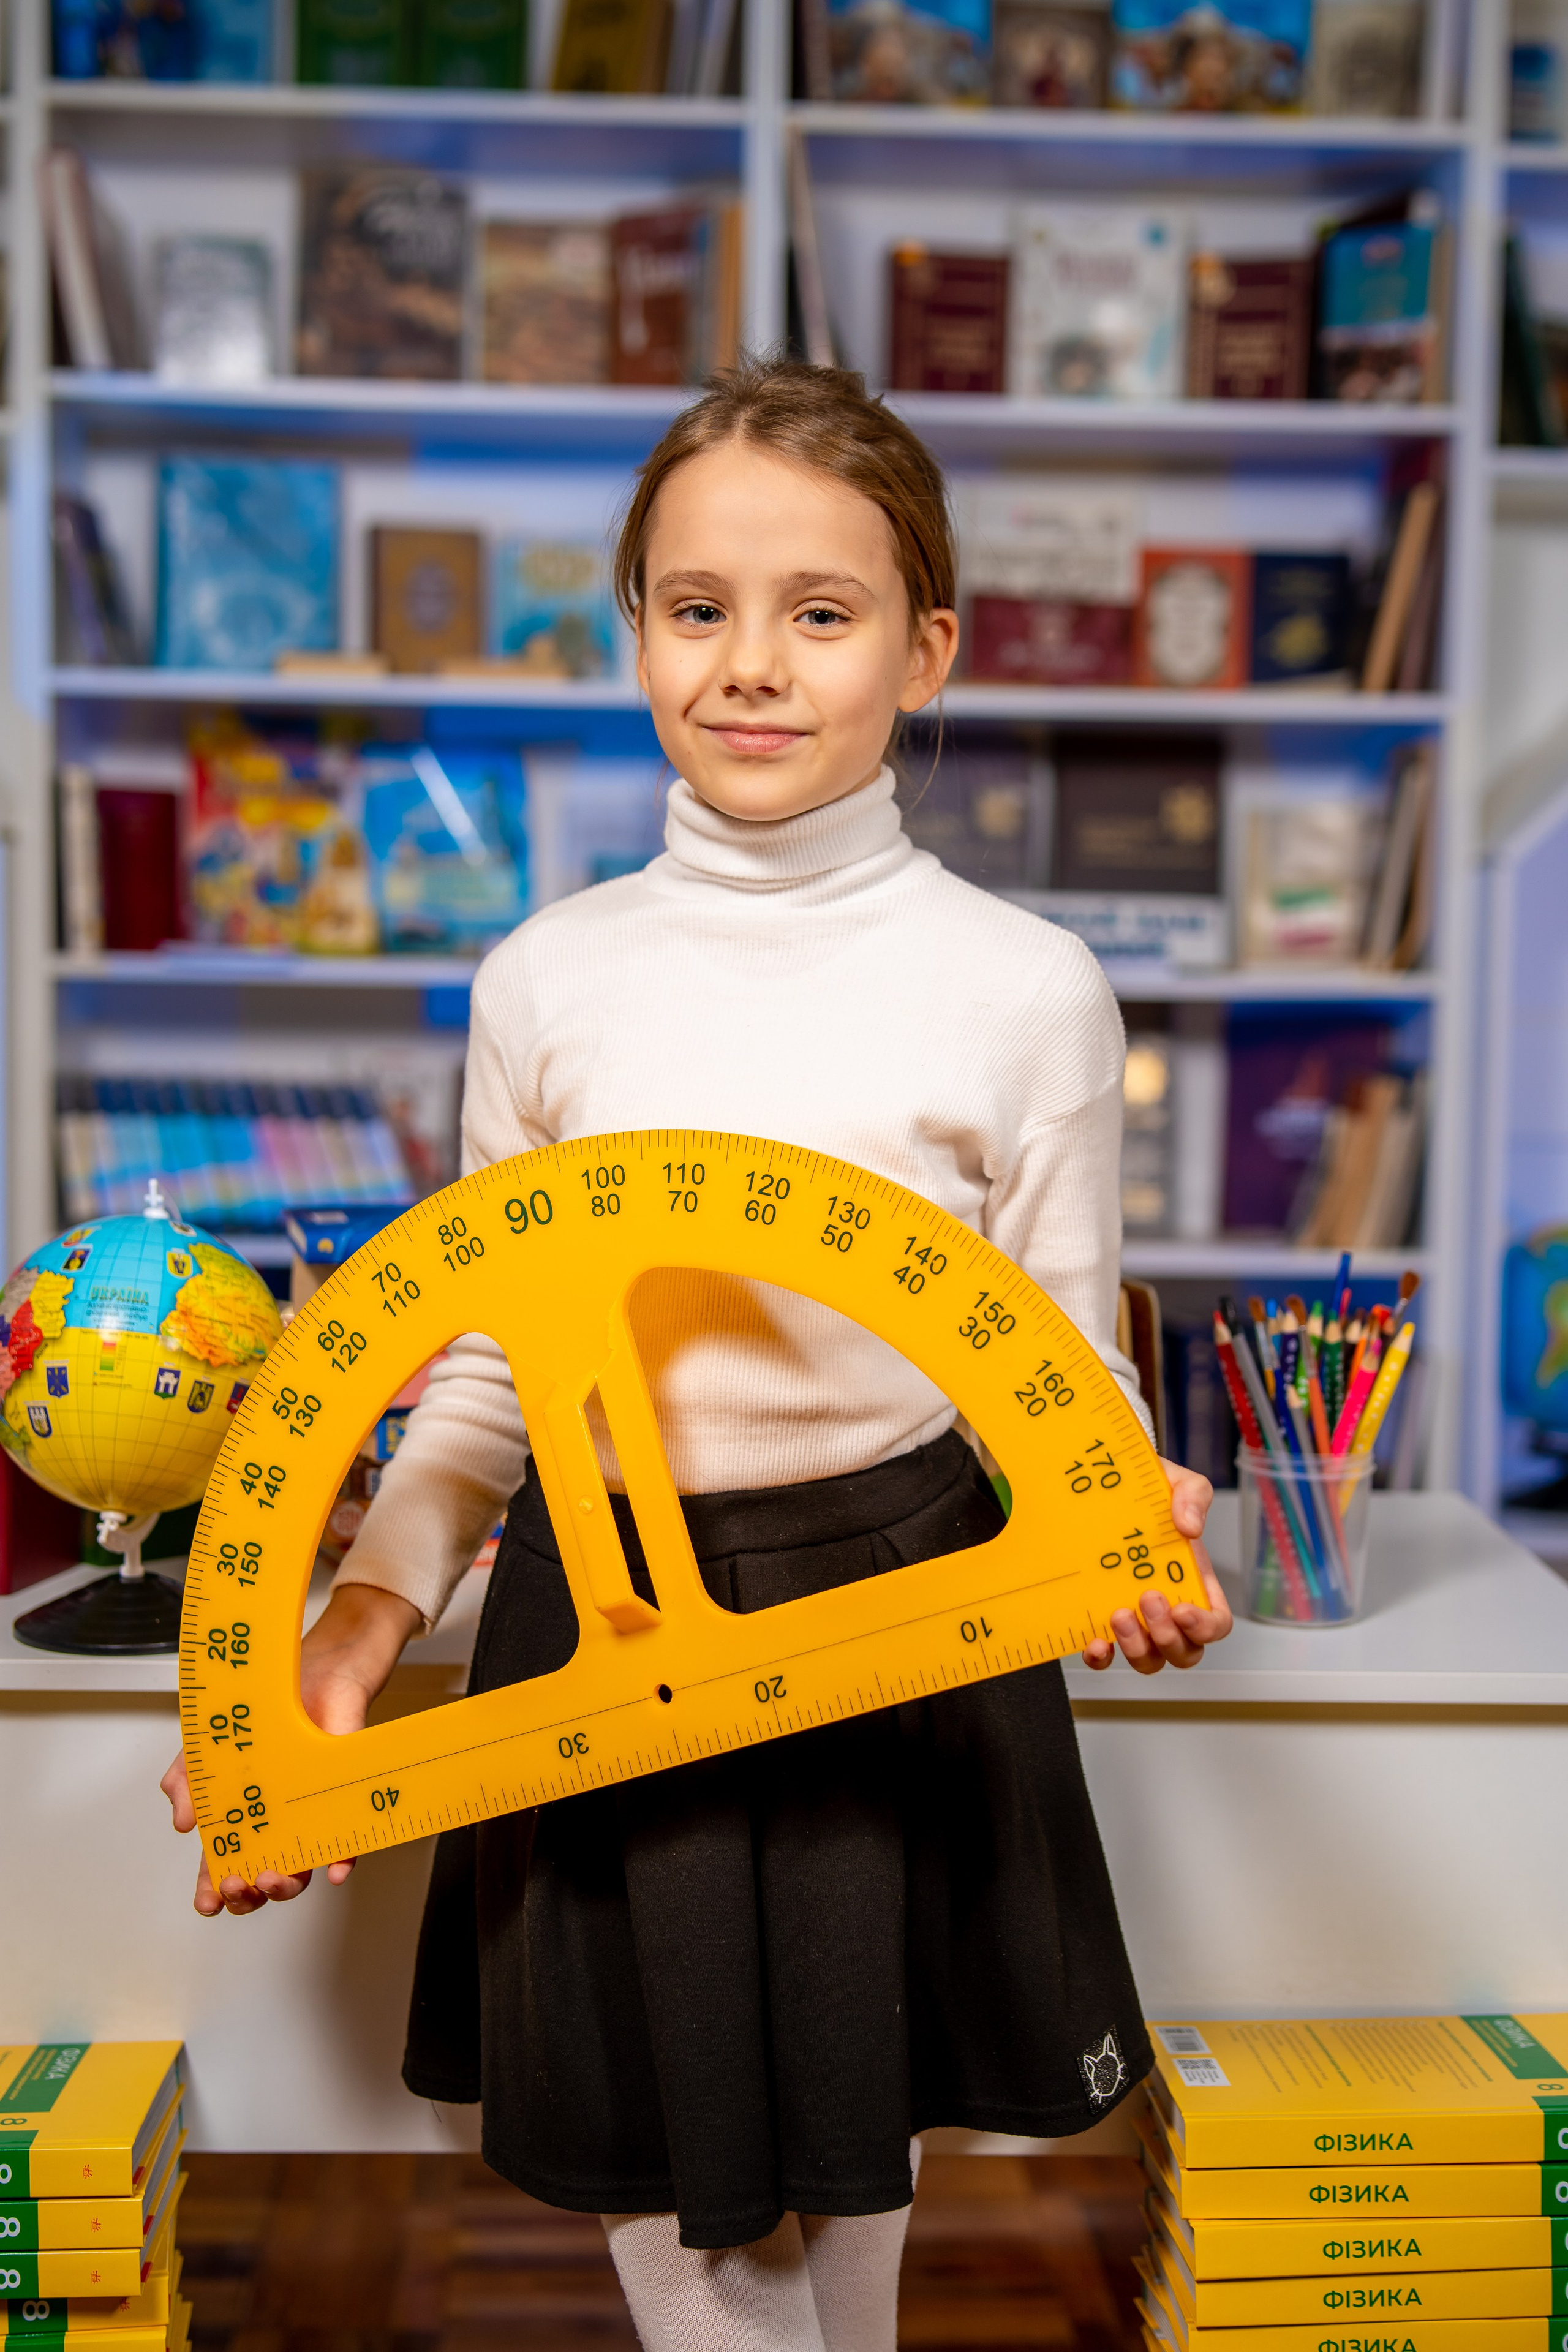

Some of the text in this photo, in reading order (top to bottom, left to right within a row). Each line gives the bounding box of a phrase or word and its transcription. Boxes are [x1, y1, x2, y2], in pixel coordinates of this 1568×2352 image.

[581, 1164, 625, 1190] 100
[663, 1162, 705, 1185] 110
[746, 1170, 790, 1200] 120
[505, 1189, 553, 1234] 90
[591, 1193, 620, 1217] 80
[668, 1190, 698, 1213] 70
[745, 1200, 776, 1226] 60
[828, 1196, 870, 1230] 130
[437, 1216, 467, 1245] 80
[821, 1224, 853, 1253] 50
[443, 1237, 485, 1272] 100
[905, 1236, 947, 1275] 140
[371, 1262, 401, 1293] 70
[893, 1266, 925, 1294] 40
[383, 1280, 420, 1317] 110
[974, 1292, 1016, 1335] 150
[317, 1319, 345, 1351] 60
[959, 1316, 990, 1349] 30
[331, 1332, 367, 1373] 120
[1035, 1360, 1074, 1407] 160
[271, 1387, 298, 1420] 50
[1014, 1382, 1047, 1417] 20
[289, 1395, 322, 1438] 130
[239, 1462, 263, 1496] 40
[1065, 1461, 1092, 1493] 10
[1085, 1439, 1121, 1489] 170
[257, 1465, 287, 1509] 140
[217, 1543, 239, 1577] 30
[238, 1542, 262, 1588] 150
[1100, 1552, 1121, 1569] 0
[1123, 1528, 1155, 1580] 180
[1167, 1561, 1184, 1583] 0
[207, 1628, 227, 1662] 20
[960, 1616, 993, 1643] 10
[230, 1622, 251, 1670] 160
[754, 1675, 787, 1703] 20
[209, 1714, 230, 1745] 10
[231, 1703, 253, 1752] 170
[558, 1732, 589, 1759] 30
[243, 1785, 269, 1833] 180
[371, 1787, 400, 1812] 40
[225, 1808, 244, 1825] 0
[213, 1831, 241, 1857] 50
[1314, 2133, 1414, 2153] ФІЗИКА
[1308, 2184, 1410, 2204] ФІЗИКА
[1322, 2238, 1422, 2260] ФІЗИКА
[22, 2300, 50, 2321] 8
[1322, 2288, 1423, 2310] ФІЗИКА
[1317, 2338, 1417, 2352] ФІЗИКА
